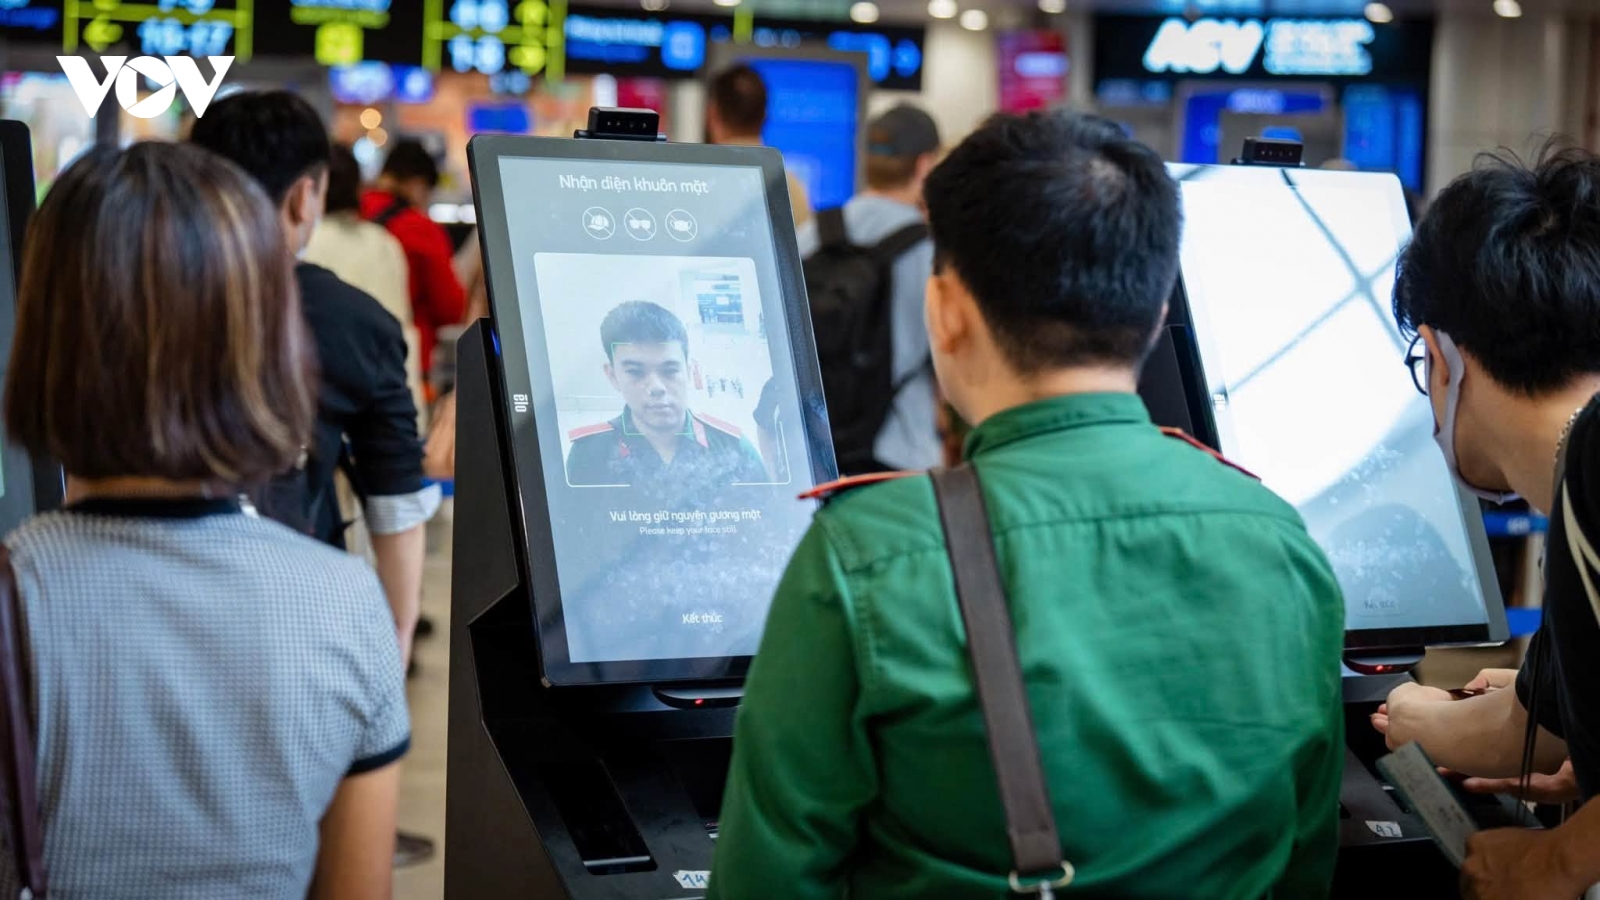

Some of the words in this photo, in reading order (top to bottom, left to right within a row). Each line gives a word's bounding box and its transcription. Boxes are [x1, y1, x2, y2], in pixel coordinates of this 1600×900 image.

[559, 174, 598, 192] Nhận
[601, 175, 631, 193] diện
[633, 176, 677, 193] khuôn
[680, 179, 708, 196] mặt
[609, 510, 627, 522] Vui
[629, 510, 651, 523] lòng
[653, 510, 669, 523] giữ
[671, 510, 707, 523] nguyên
[639, 527, 665, 535] Please
[666, 526, 685, 535] keep
[686, 527, 703, 535] your
[704, 525, 720, 534] face
[682, 612, 700, 624] Kết
[701, 612, 723, 623] thúc
